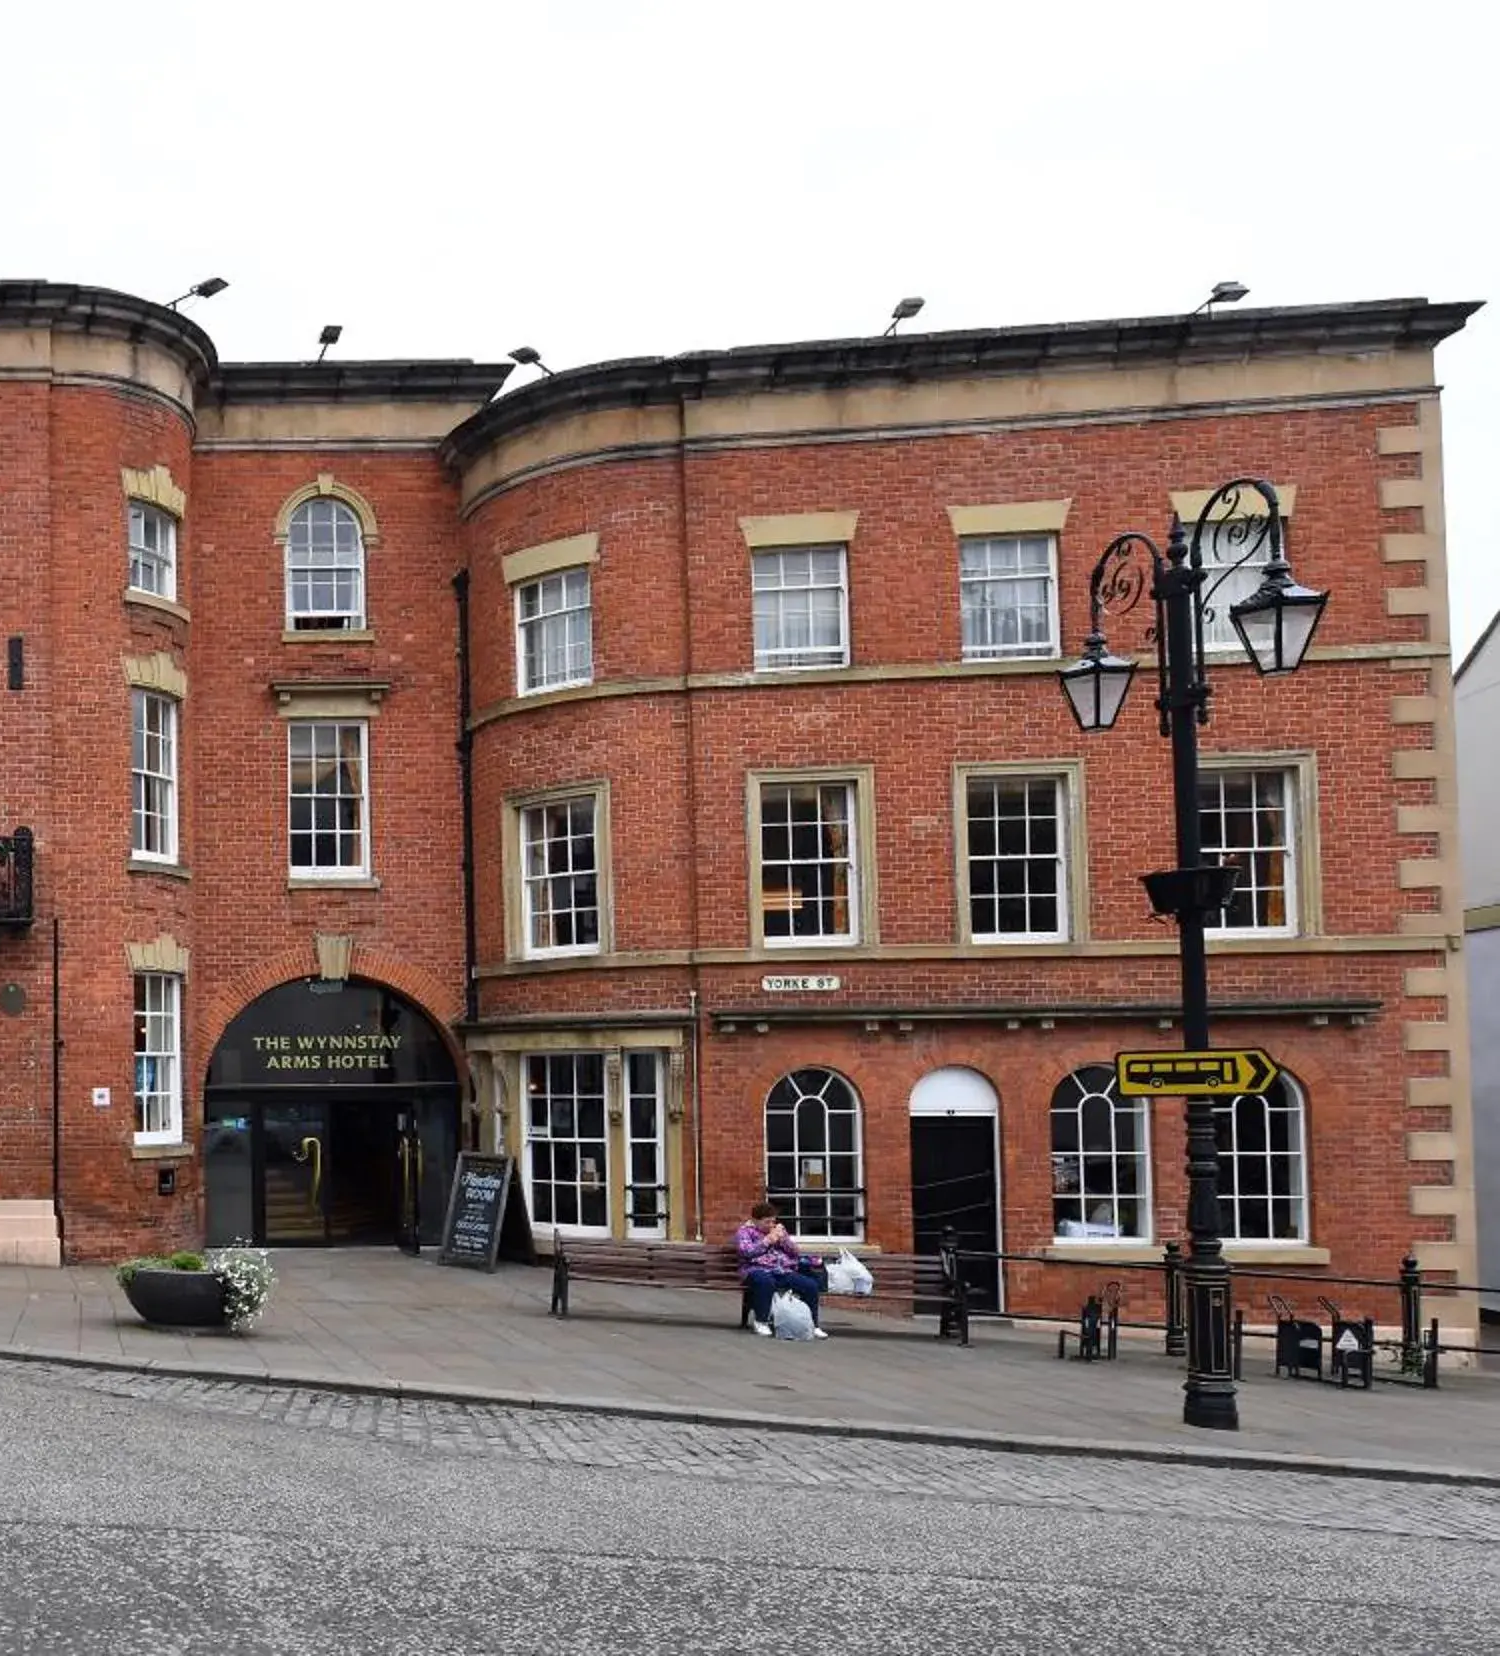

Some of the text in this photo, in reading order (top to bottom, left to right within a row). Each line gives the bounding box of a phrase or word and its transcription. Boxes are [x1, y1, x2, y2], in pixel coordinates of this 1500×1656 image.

[767, 977, 834, 989] YORKE ST
[252, 1034, 401, 1050] THE WYNNSTAY
[266, 1054, 390, 1069] ARMS HOTEL
